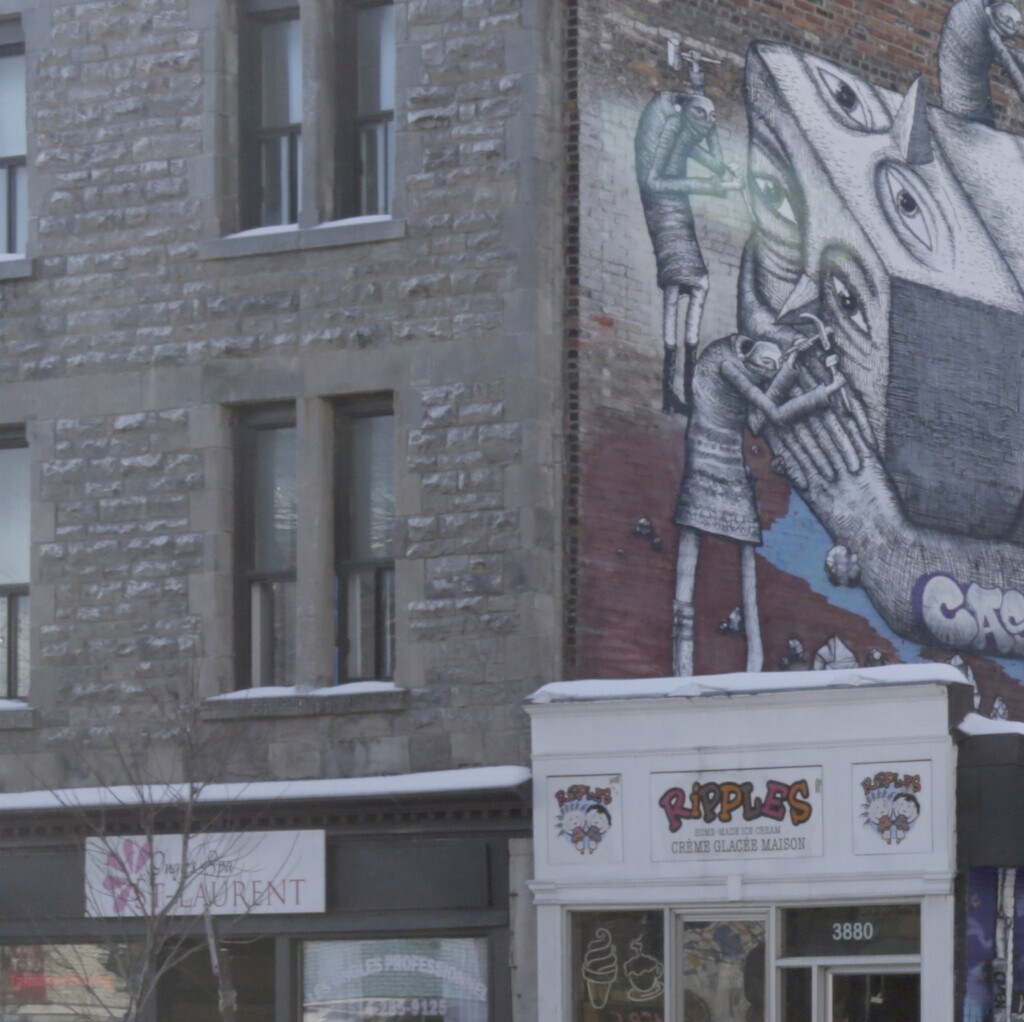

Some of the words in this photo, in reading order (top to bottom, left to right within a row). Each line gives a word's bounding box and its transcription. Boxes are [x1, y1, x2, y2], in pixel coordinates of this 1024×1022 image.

[741, 826, 753, 835] ICE
[754, 825, 781, 835] CREAM
[671, 838, 710, 854] CRÈME
[713, 836, 758, 853] GLACÉE
[761, 837, 806, 851] MAISON
[133, 878, 306, 909] ST-LAURENT
[832, 922, 873, 940] 3880
